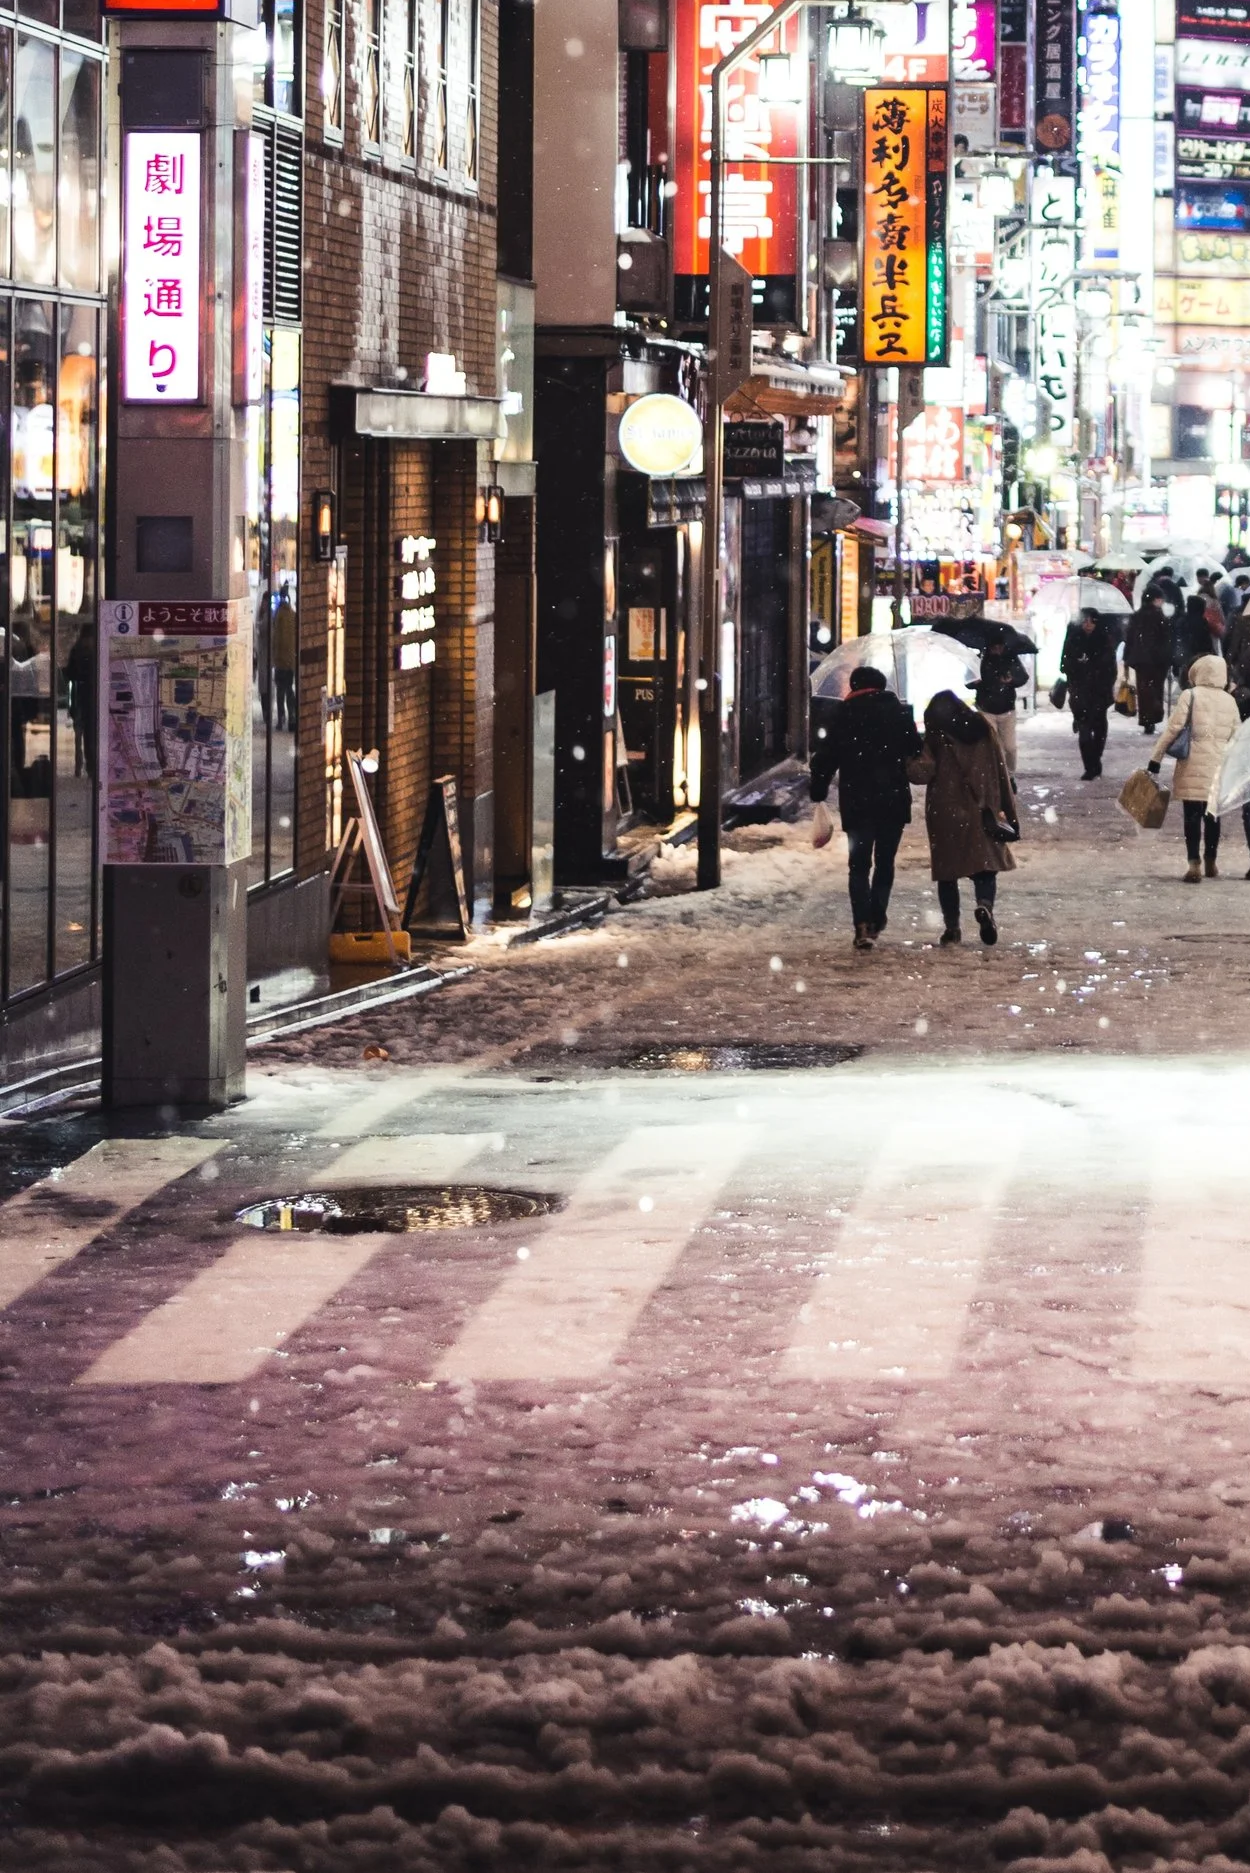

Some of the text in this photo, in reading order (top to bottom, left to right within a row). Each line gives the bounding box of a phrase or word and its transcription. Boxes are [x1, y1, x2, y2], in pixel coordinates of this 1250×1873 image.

[884, 56, 928, 82] 4F
[144, 152, 185, 379] 劇場通り
[634, 688, 656, 702] PUS
